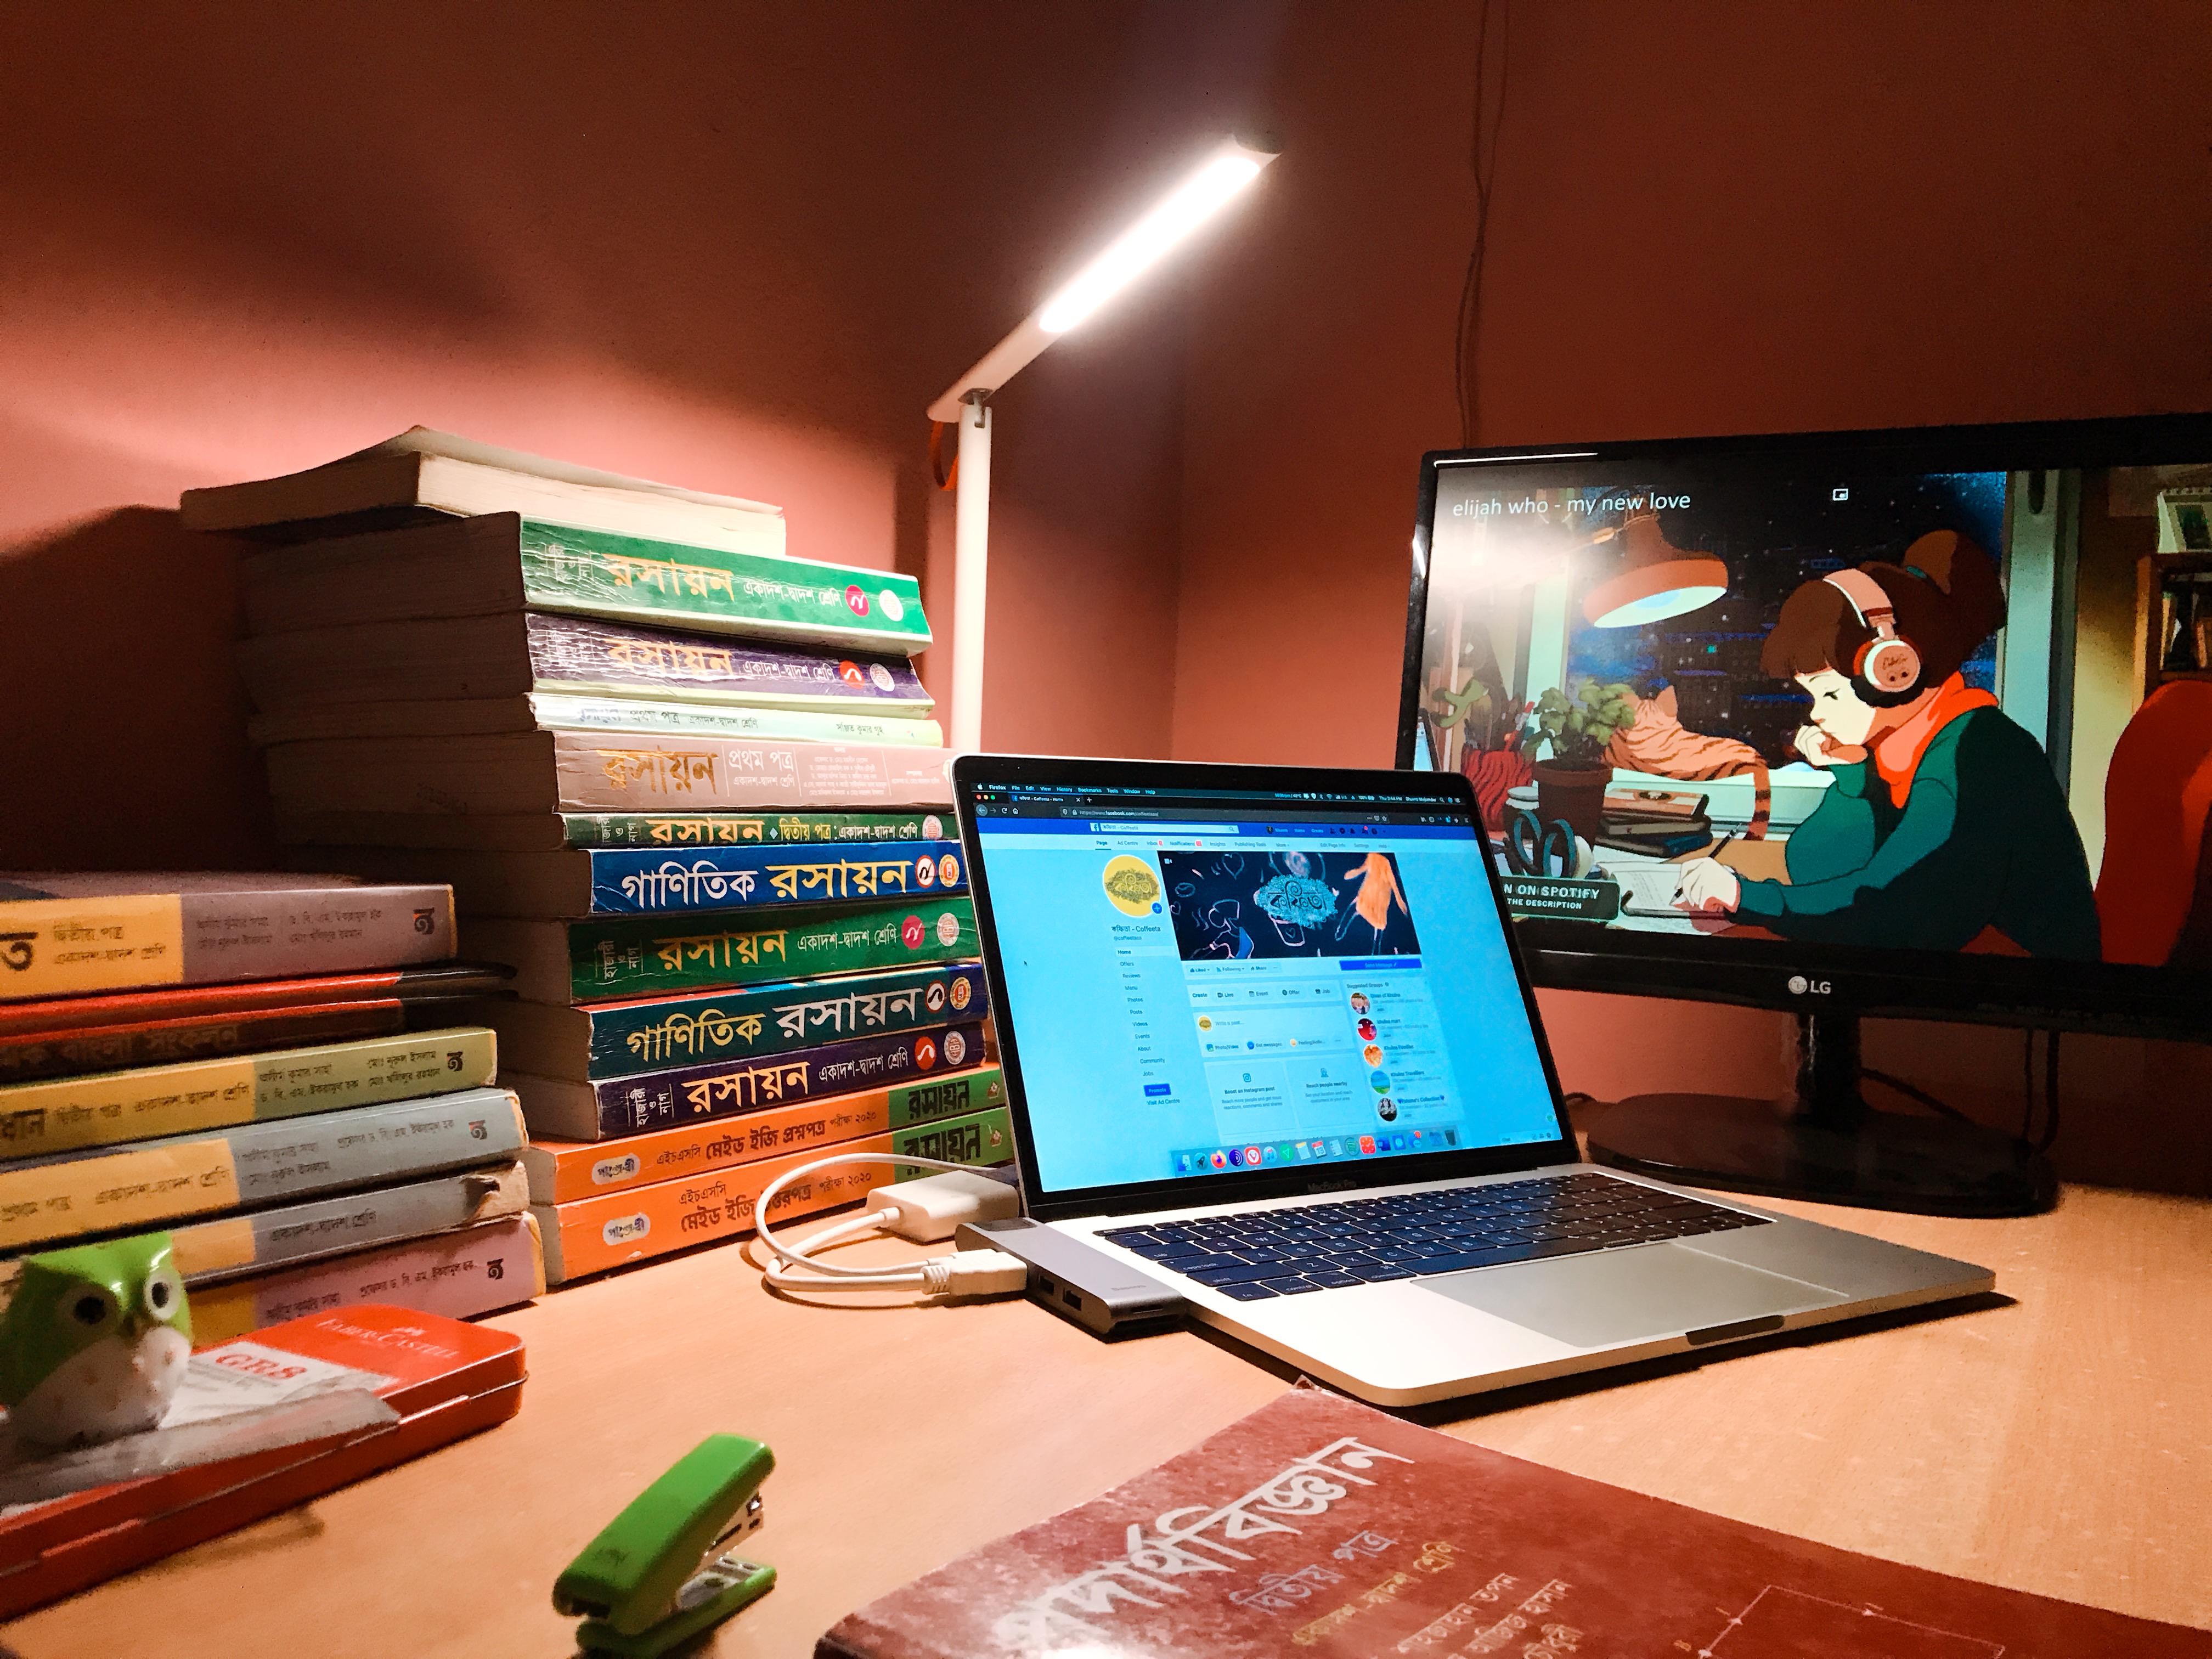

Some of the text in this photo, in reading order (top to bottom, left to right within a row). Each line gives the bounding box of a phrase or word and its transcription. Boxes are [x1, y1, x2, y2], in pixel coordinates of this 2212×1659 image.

[1453, 492, 1691, 518] elijah who my new love
[601, 552, 735, 602] রসায়ন
[744, 581, 815, 603] একাদশ-দ্বাদশ
[604, 639, 734, 677] রসায়ন
[743, 661, 810, 680] একাদশ-দ্বাদশ
[596, 745, 719, 794] রসায়ন
[729, 748, 794, 772] প্রথম পত্র
[645, 818, 765, 843] রসায়ন
[778, 817, 918, 841] দ্বিতীয় একাদশ-দ্বাদশ শ্রেণি
[622, 857, 915, 909] গাণিতিক রসায়ন
[1517, 884, 1600, 900] ON SPOTIFY
[1526, 899, 1582, 910] DESCRIPTION
[652, 923, 897, 972] রসায়ন একাদশ-দ্বাদশ শ্রেণি
[1810, 980, 1832, 995] LG
[627, 988, 924, 1063] গাণিতিক রসায়ন
[681, 1046, 909, 1114] রসায়ন একাদশ-দ্বাদশ শ্রেণি
[908, 1079, 970, 1121] রসায়ন
[656, 1144, 701, 1165] এইচএসসি
[707, 1135, 744, 1160] মেইড
[750, 1125, 779, 1150] ইজি
[783, 1119, 827, 1144] প্রশ্নপত্র
[855, 1111, 877, 1124] ২০২০
[679, 1181, 727, 1206] এইচএসসি
[681, 1205, 721, 1233] মেইড
[848, 1173, 872, 1186] ২০২০
[1228, 1530, 1400, 1616] দ্বিতীয় পত্র
